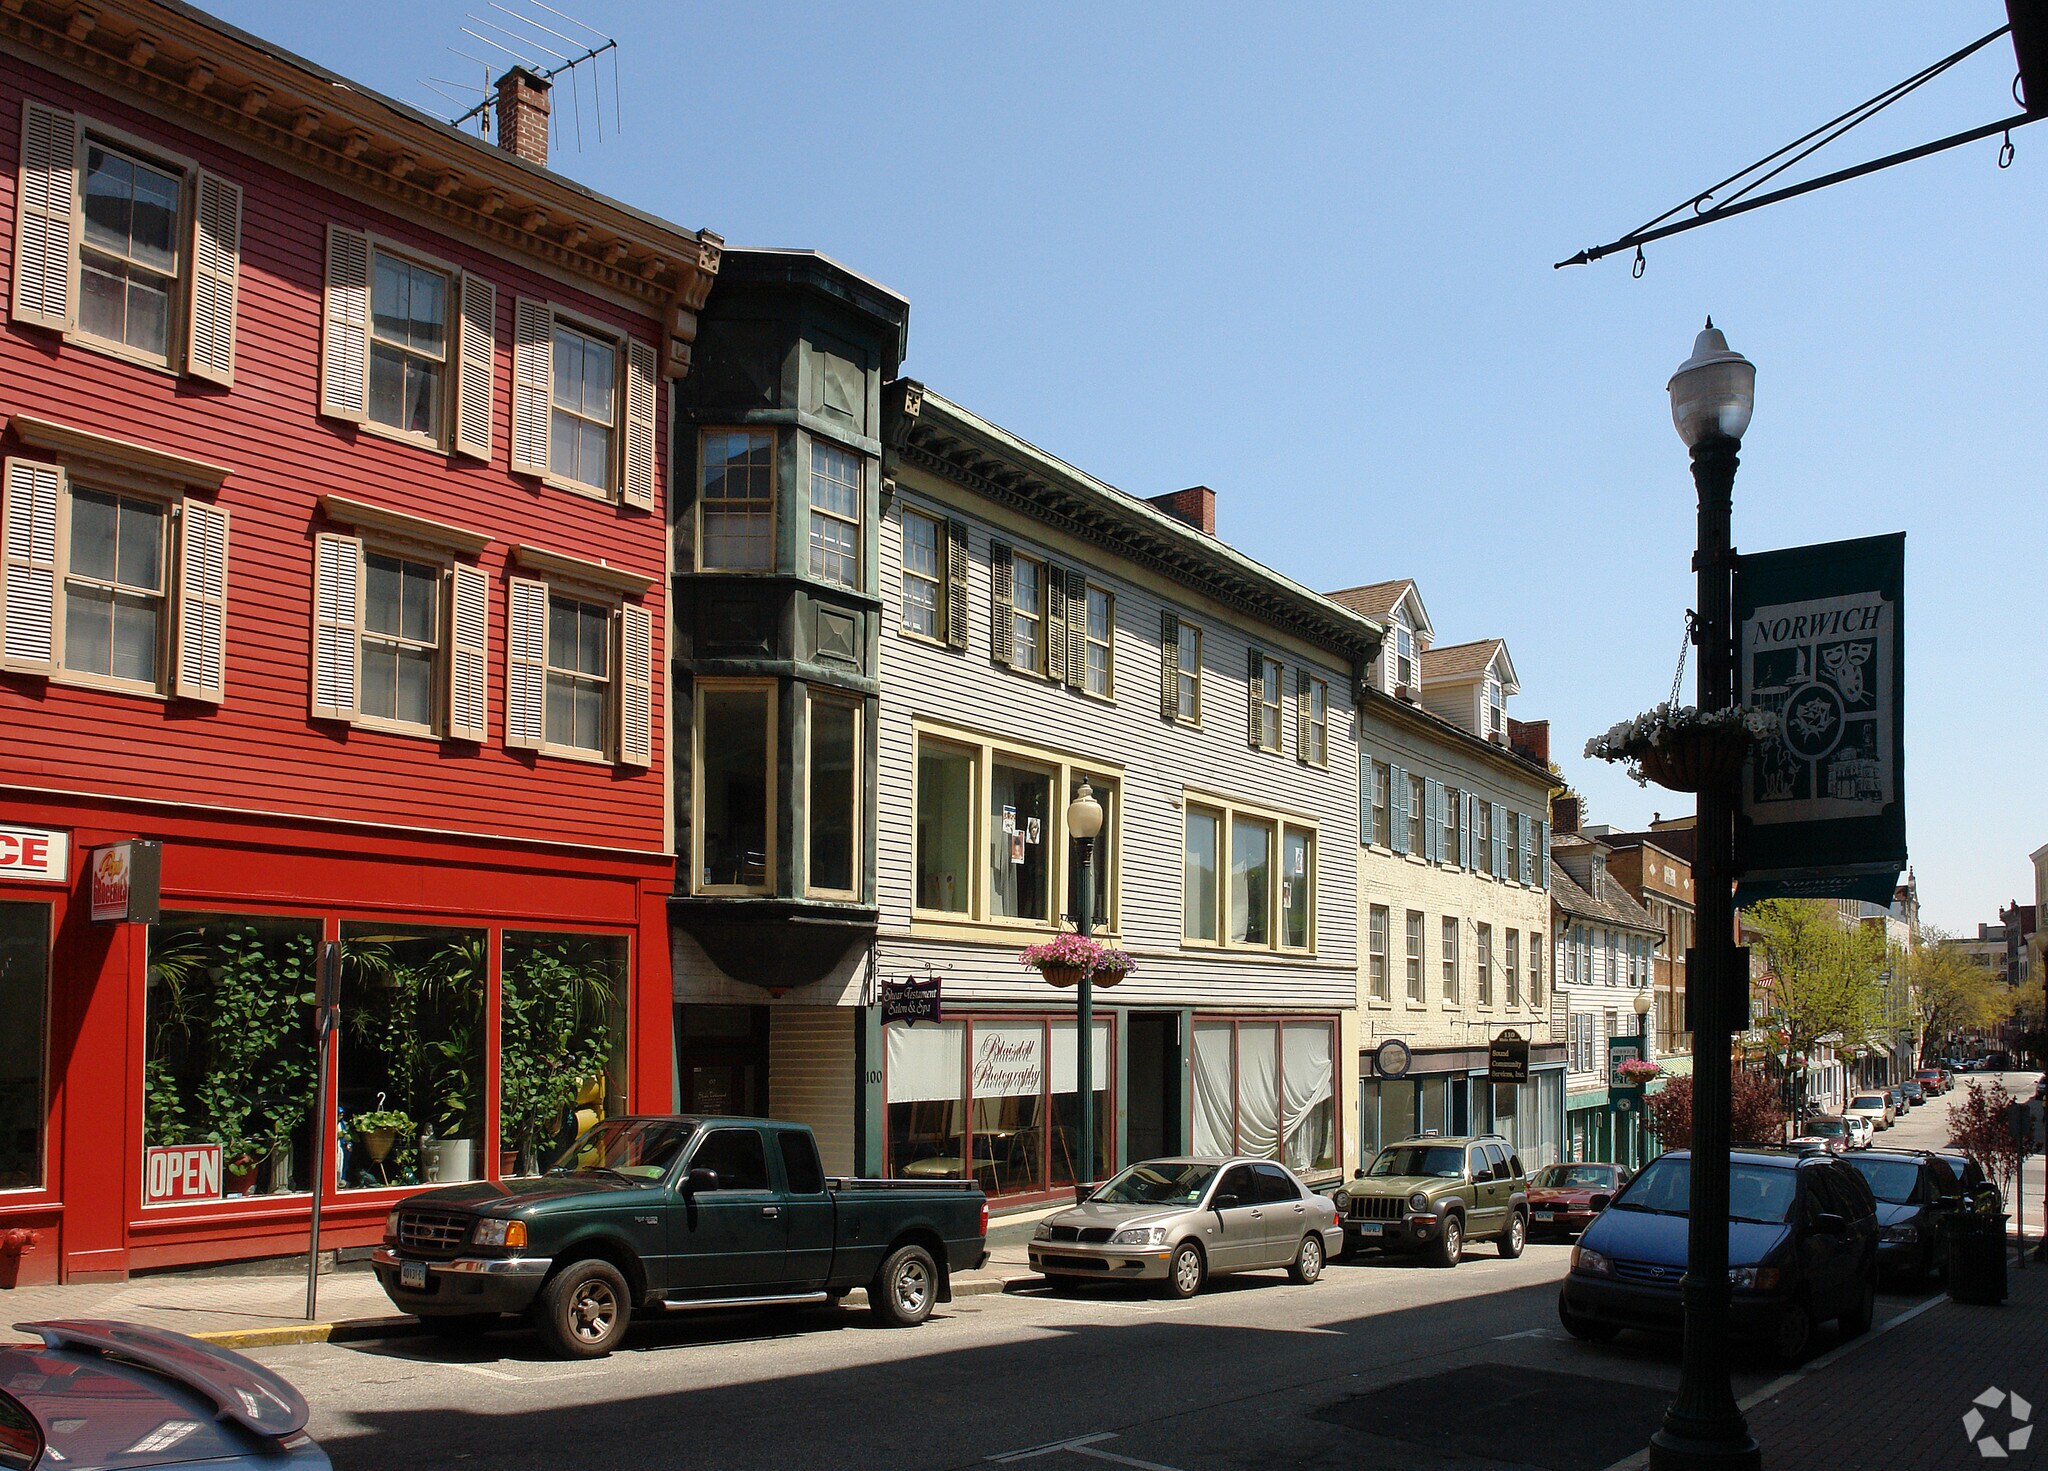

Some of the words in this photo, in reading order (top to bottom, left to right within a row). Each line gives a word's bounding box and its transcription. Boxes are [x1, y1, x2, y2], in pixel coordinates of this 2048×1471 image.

[1753, 605, 1883, 645] NORWICH
[883, 988, 904, 1001] Shear
[903, 986, 937, 999] Testament
[888, 1001, 908, 1015] Salon
[907, 1001, 916, 1013] &
[916, 1000, 931, 1015] Spa
[981, 1033, 1035, 1062] Blaisdell
[1492, 1061, 1522, 1069] Community
[866, 1070, 882, 1083] 100
[973, 1060, 1041, 1095] Photography
[150, 1149, 219, 1197] OPEN
